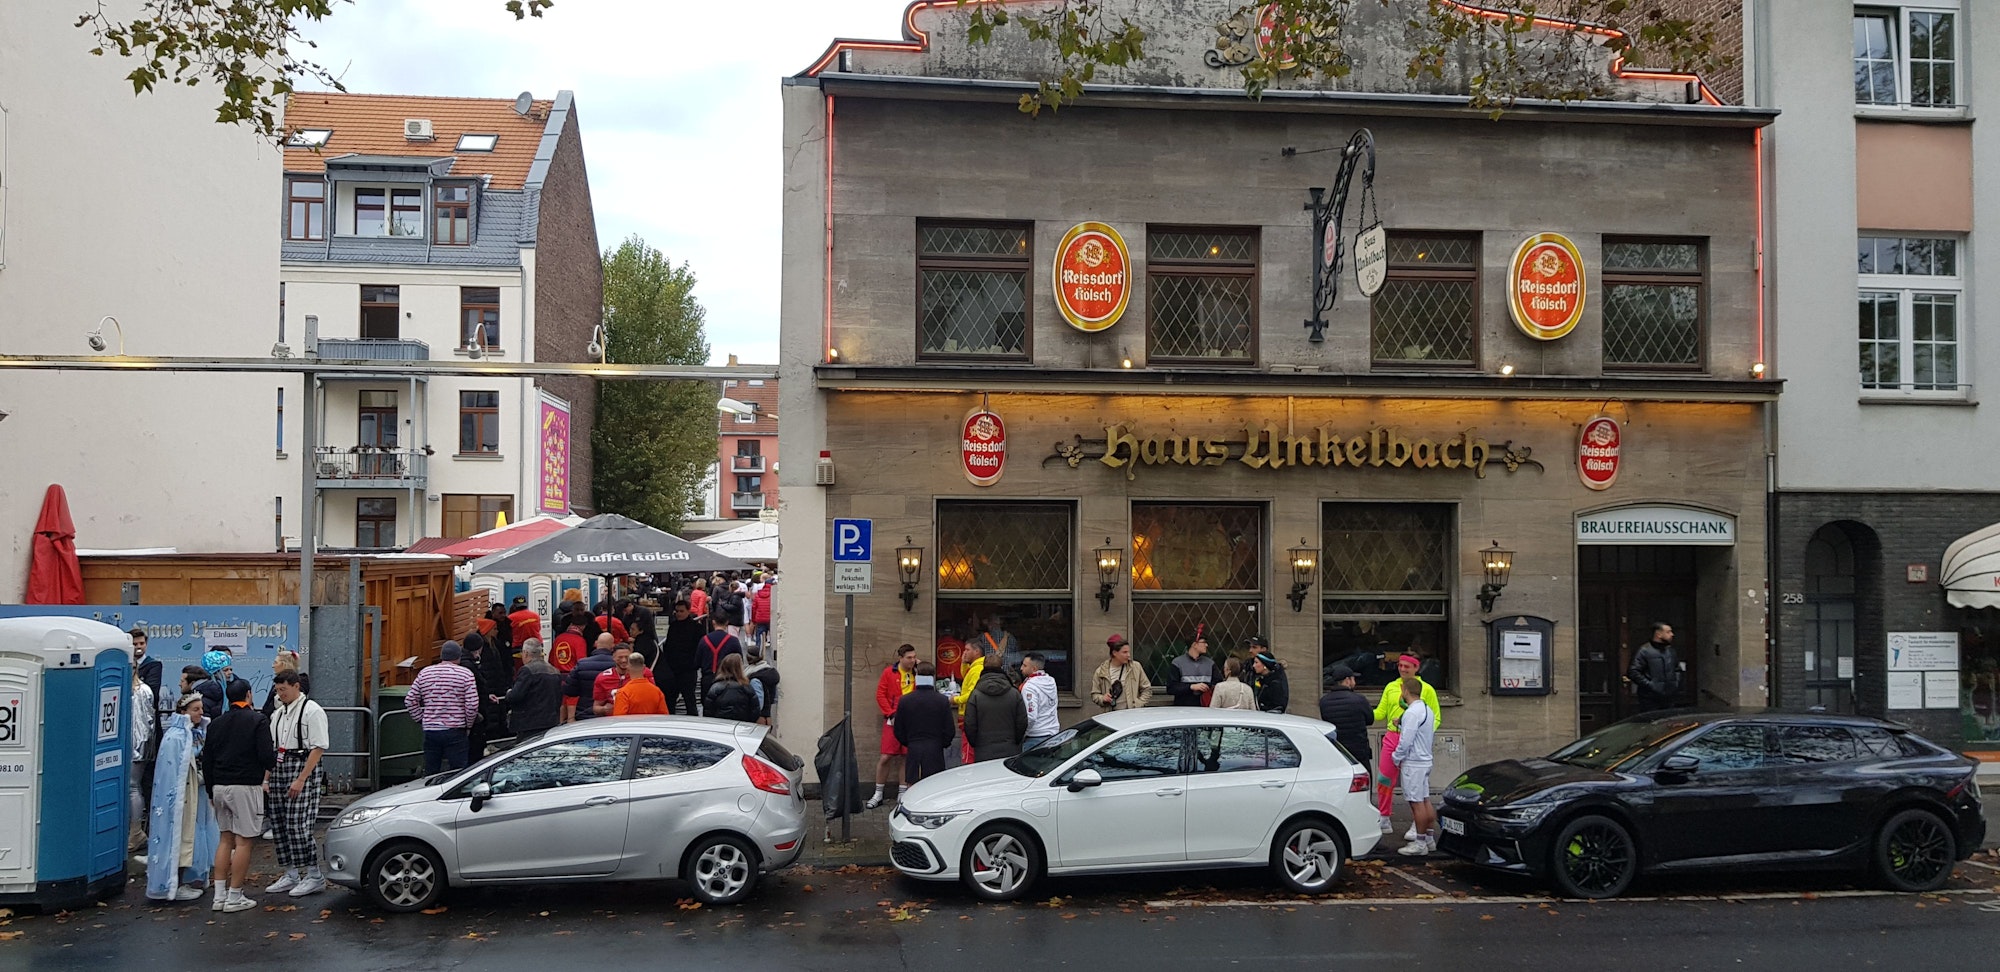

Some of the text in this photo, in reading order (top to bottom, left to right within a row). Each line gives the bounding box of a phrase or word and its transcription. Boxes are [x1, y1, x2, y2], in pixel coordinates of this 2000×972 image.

[1364, 236, 1376, 252] Haus
[1063, 269, 1124, 285] Reissdorf
[1520, 280, 1579, 295] Reissdorf
[1073, 287, 1112, 303] Kölsch
[1530, 296, 1567, 312] Kölsch
[963, 440, 1005, 453] Reissdorf
[1100, 420, 1491, 481] Haus Unkelbach
[1581, 445, 1620, 457] Reissdorf
[969, 454, 999, 468] Kölsch
[1586, 458, 1614, 472] Kölsch
[1581, 520, 1728, 534] BRAUEREIAUSSCHANK
[839, 524, 860, 556] P
[576, 550, 690, 563] Gaffel Kölsch
[1782, 593, 1804, 604] 258
[213, 630, 238, 638] Einlass
[0, 706, 17, 723] OI
[0, 724, 16, 741] OI
[14, 764, 24, 773] 00
